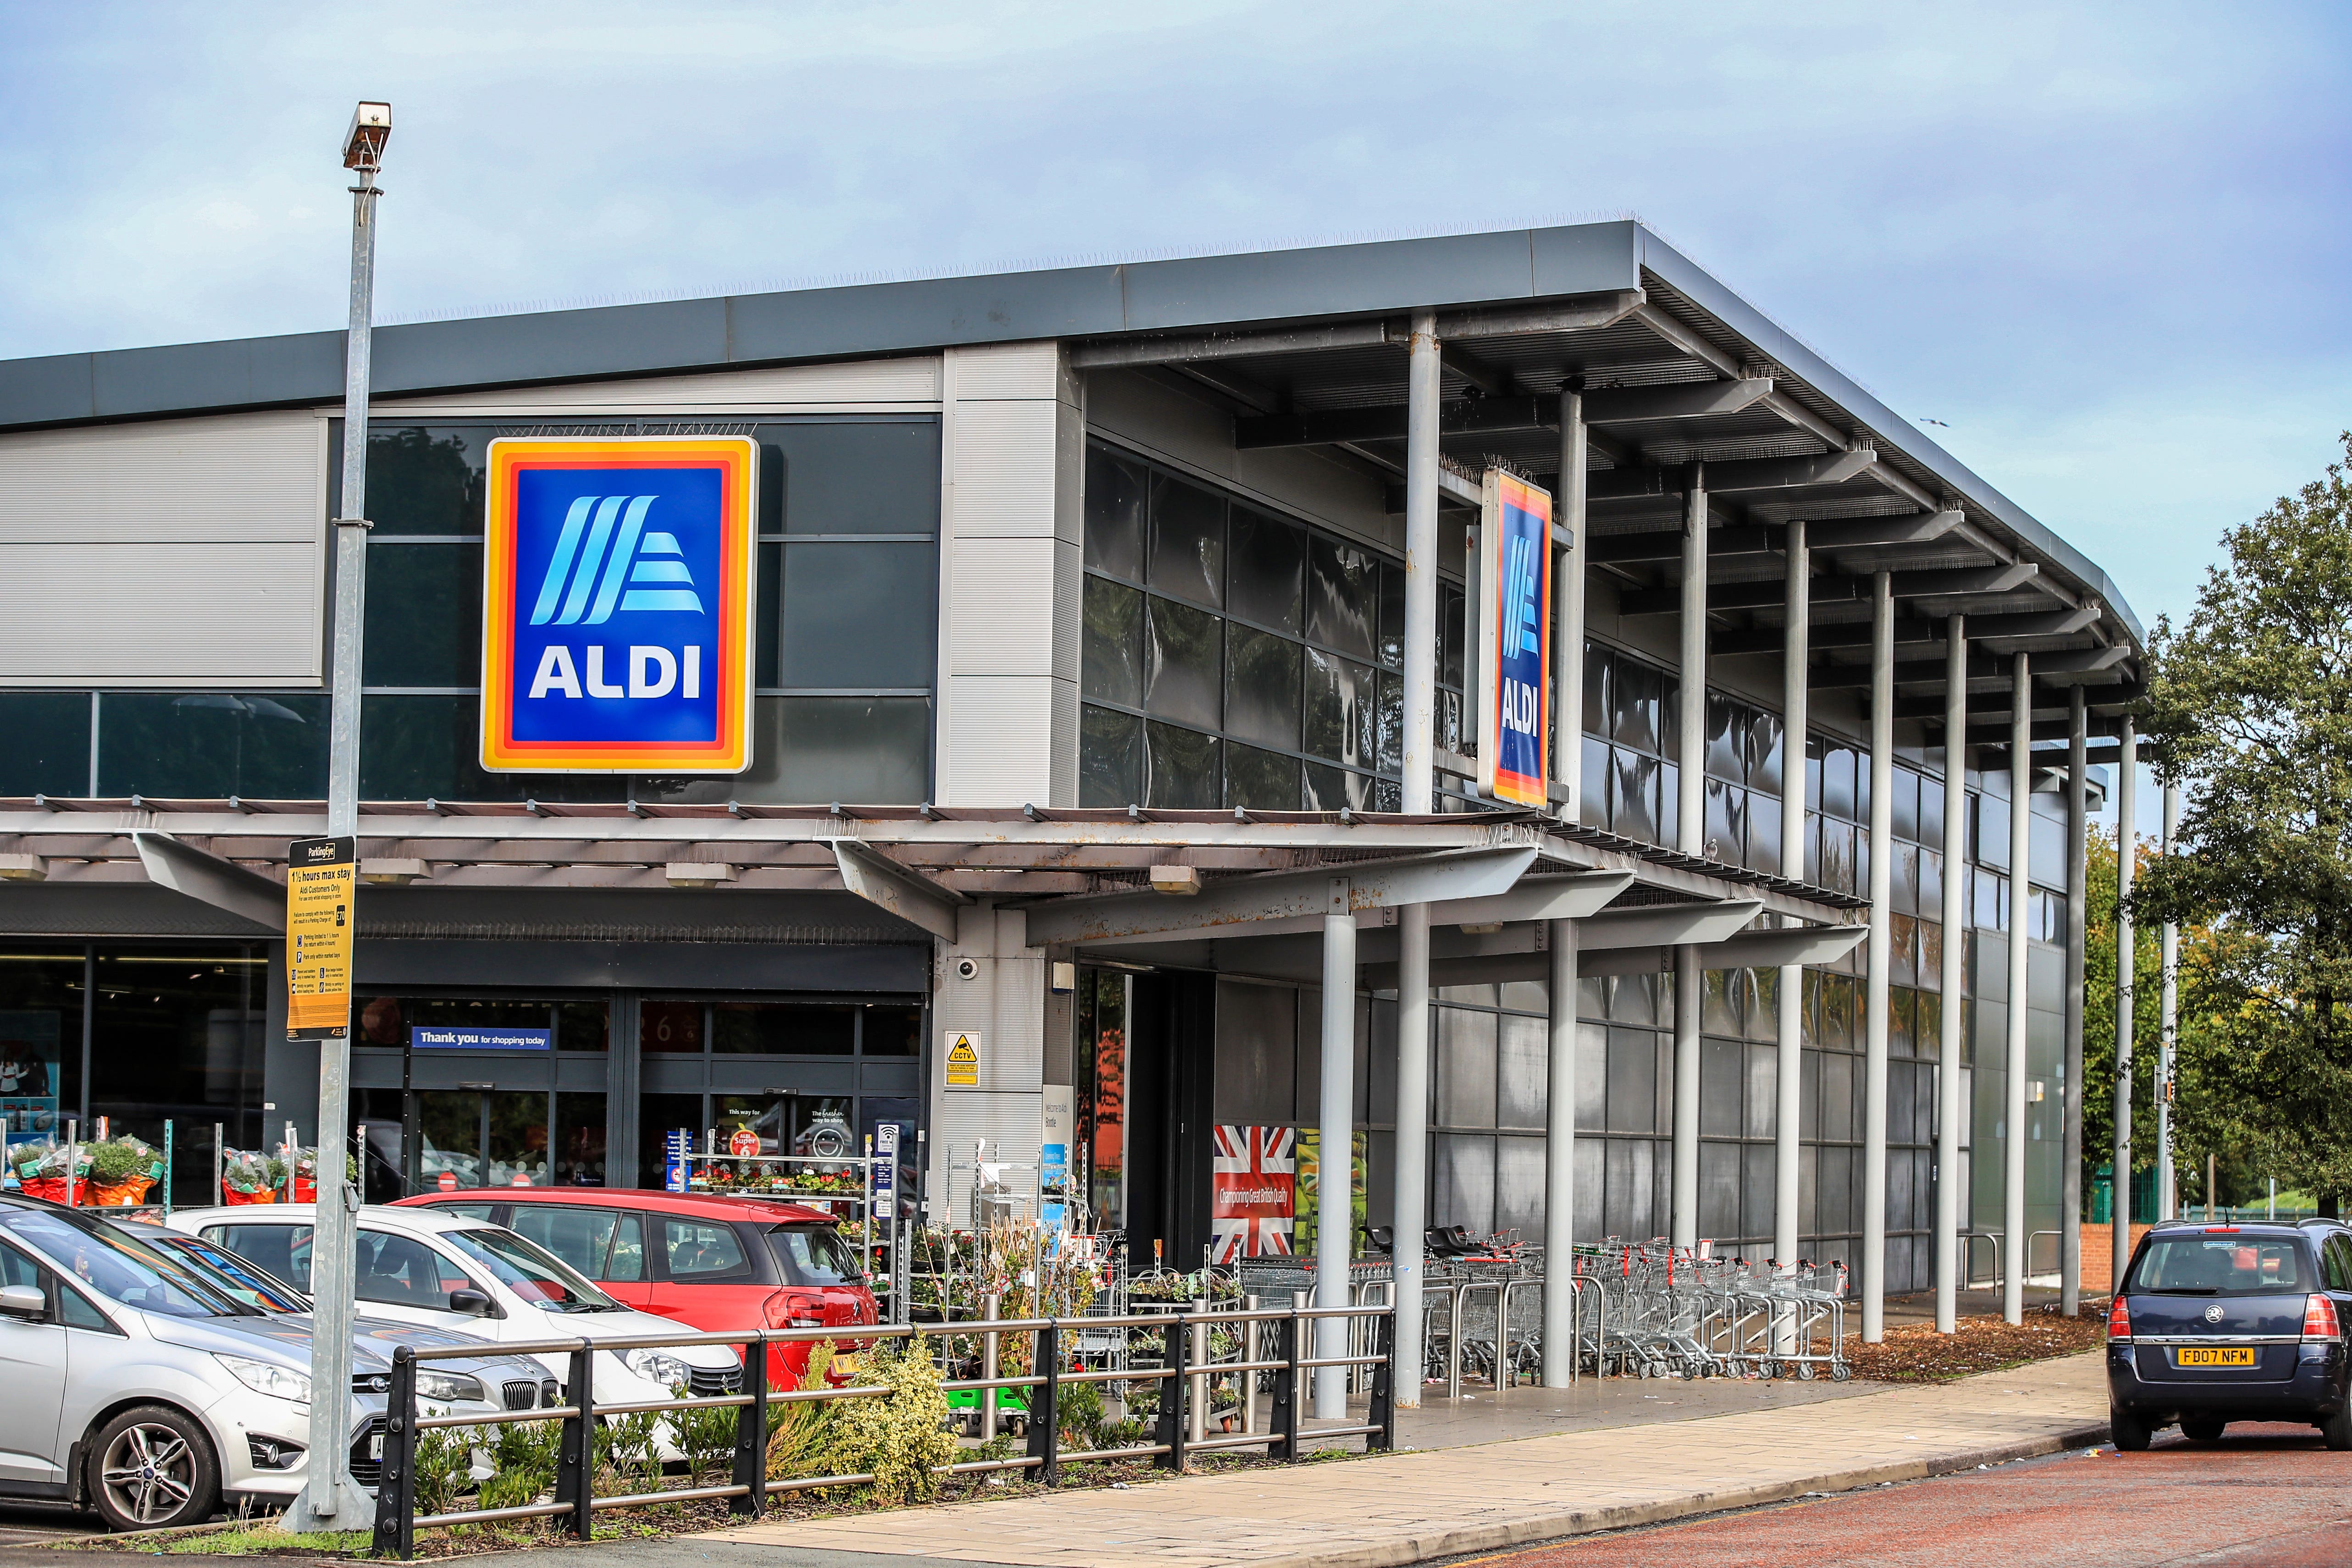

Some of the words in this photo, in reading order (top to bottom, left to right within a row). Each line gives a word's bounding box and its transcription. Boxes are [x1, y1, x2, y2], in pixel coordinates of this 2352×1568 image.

[528, 645, 700, 699] ALDI
[1502, 676, 1538, 737] ALDI
[308, 846, 334, 858] ParkingEye
[302, 871, 320, 881] hours
[322, 871, 335, 880] max
[337, 868, 351, 880] stay
[309, 885, 330, 894] Customers
[331, 884, 340, 893] Only
[421, 1032, 456, 1043] Thank
[458, 1034, 478, 1045] you
[481, 1035, 491, 1043] for
[492, 1036, 524, 1045] shopping
[526, 1038, 545, 1046] today
[822, 1109, 844, 1117] fresher
[1046, 1117, 1056, 1127] Bootle
[740, 1146, 751, 1156] 6
[1220, 1187, 1249, 1207] Championing
[1249, 1188, 1260, 1203] Great
[1261, 1187, 1273, 1203] British
[1274, 1187, 1287, 1207] Quality
[2184, 1350, 2218, 1362] FD07
[2222, 1350, 2247, 1362] NFM
